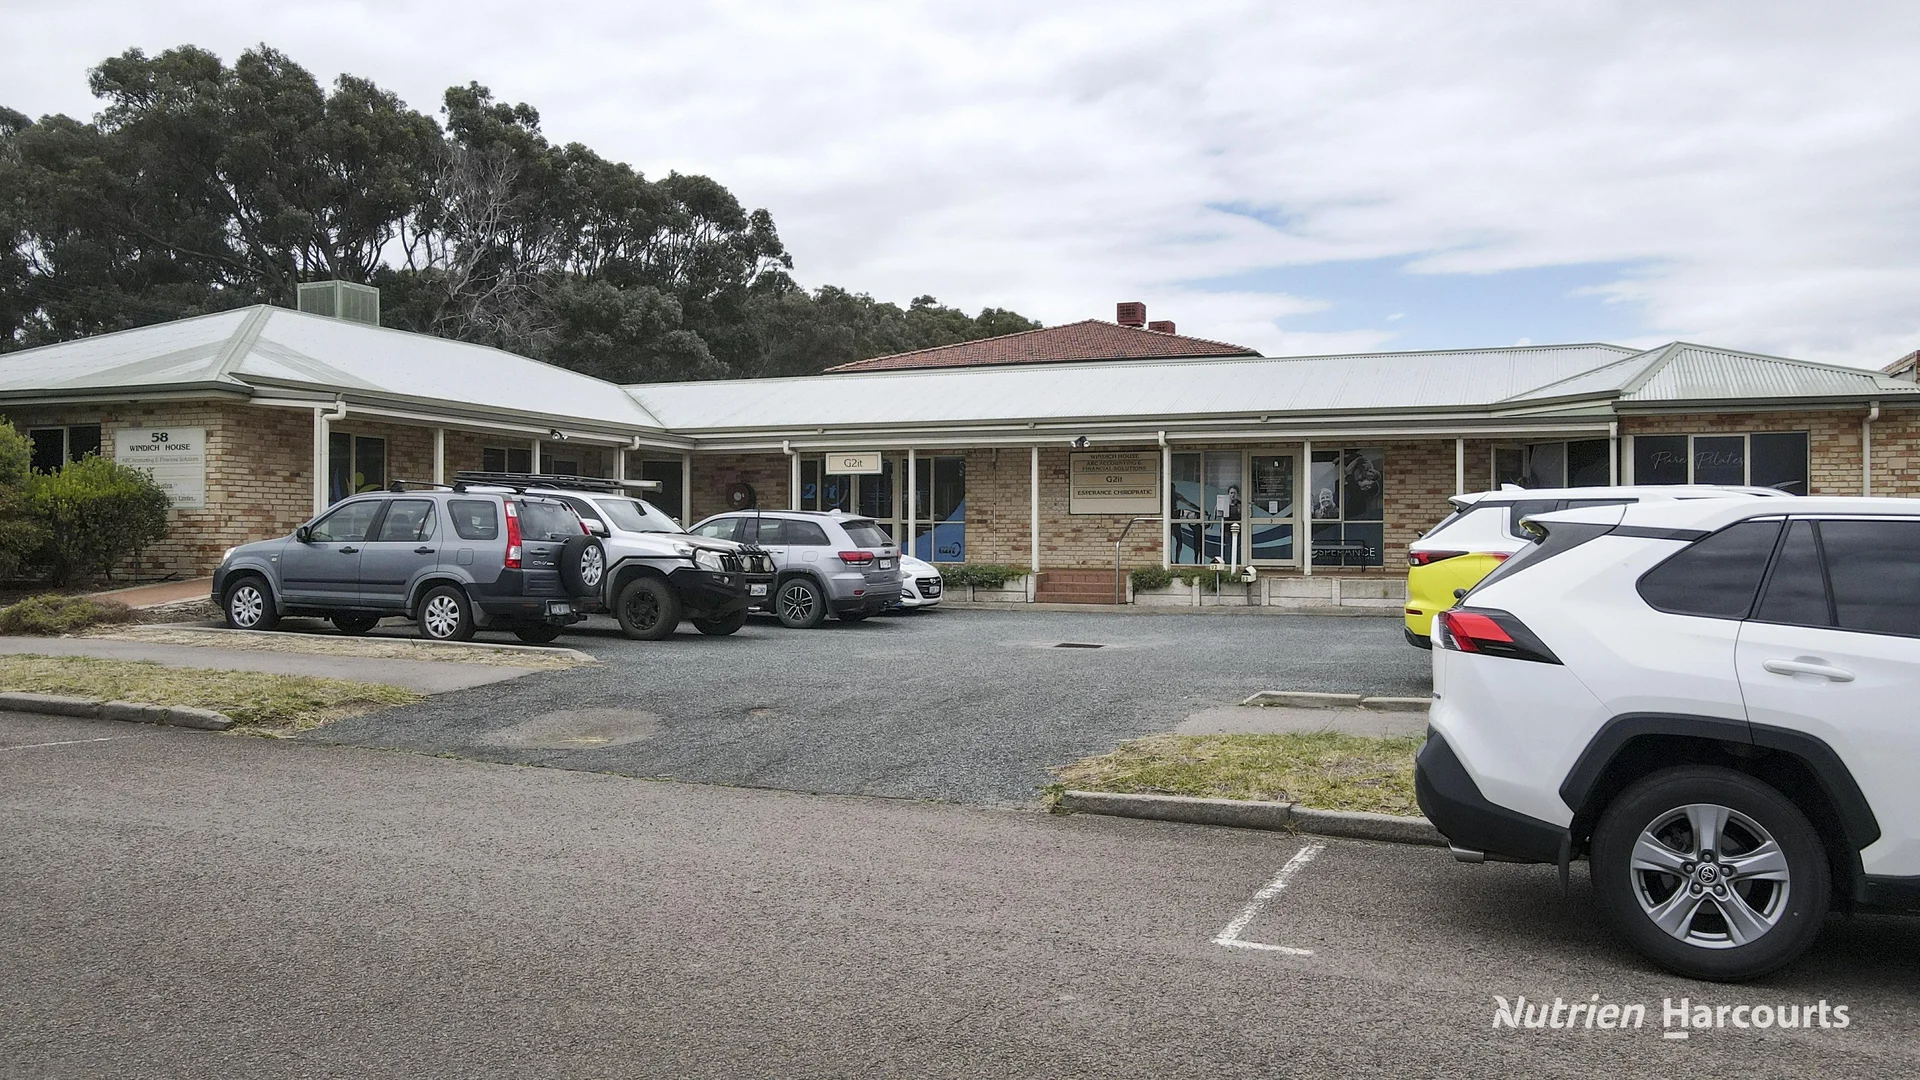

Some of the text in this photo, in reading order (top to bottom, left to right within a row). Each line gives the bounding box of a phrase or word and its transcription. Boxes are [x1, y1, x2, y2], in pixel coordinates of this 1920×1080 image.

[151, 432, 169, 443] 58
[165, 443, 191, 451] HOUSE
[843, 458, 863, 468] G2it
[1105, 475, 1123, 483] G2it
